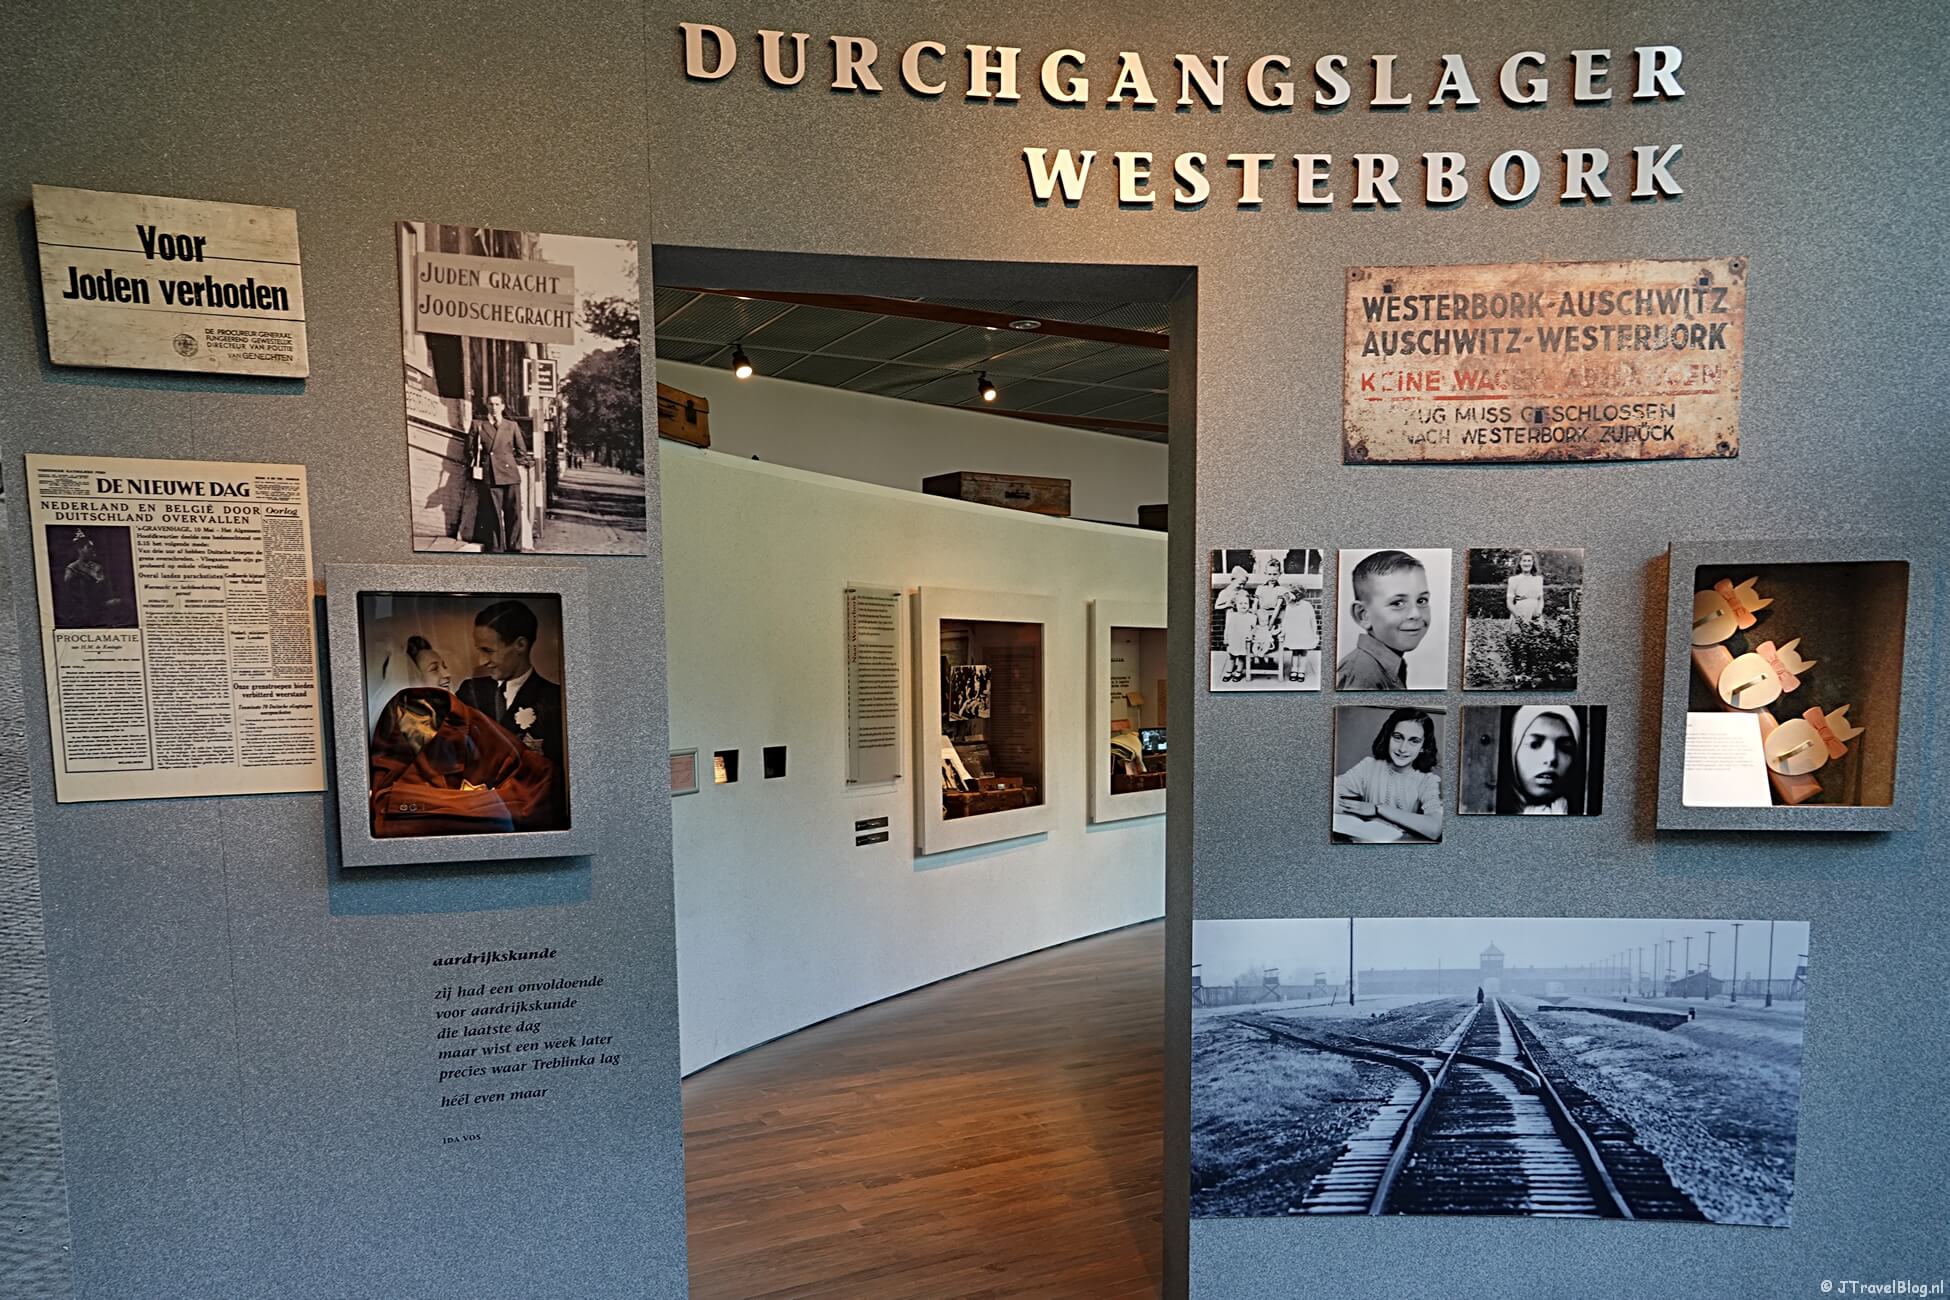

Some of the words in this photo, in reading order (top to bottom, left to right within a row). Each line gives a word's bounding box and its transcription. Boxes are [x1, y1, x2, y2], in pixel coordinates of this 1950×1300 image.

[679, 21, 1687, 107] DURCHGANGSLAGER
[1022, 142, 1685, 206] WESTERBORK
[136, 224, 206, 263] Voor
[63, 266, 150, 305] Joden
[159, 275, 289, 311] verboden
[420, 262, 481, 287] JUDEN
[489, 271, 561, 295] GRACHT
[419, 294, 575, 329] JOODSCHEGRACHT
[1362, 287, 1730, 322] WESTERBORK-AUSCHWITZ
[1455, 406, 1512, 424] MUSS
[1599, 422, 1675, 444] ZURÜCK
[96, 478, 124, 494] DE
[128, 479, 206, 496] NIEUWE
[210, 482, 250, 497] DAG
[41, 501, 129, 512] NEDERLAND
[139, 504, 156, 512] EN
[223, 506, 261, 515] DOOR
[55, 511, 153, 522] DUITSCHLAND
[163, 514, 250, 525] OVERVALLEN
[56, 634, 140, 643] PROCLAMATIE
[432, 948, 558, 966] aardrijkskunde
[434, 987, 452, 1001] zij
[457, 984, 485, 998] had
[490, 984, 514, 995] een
[518, 976, 604, 993] onvoldoende
[436, 1008, 466, 1019] voor
[471, 997, 578, 1017] aardrijkskunde
[437, 1028, 458, 1040] die
[463, 1024, 512, 1037] laatste
[516, 1020, 542, 1034] dag
[438, 1046, 478, 1060] maar
[482, 1043, 512, 1056] wist
[516, 1043, 539, 1052] een
[544, 1036, 576, 1050] week
[581, 1034, 614, 1047] later
[438, 1064, 487, 1082] precies
[491, 1062, 528, 1074] waar
[532, 1055, 596, 1070] Treblinka
[600, 1053, 622, 1066] lag
[440, 1093, 470, 1108] héél
[474, 1092, 506, 1104] even
[510, 1088, 549, 1100] maar
[443, 1136, 461, 1145] IDA
[462, 1133, 482, 1142] VOS
